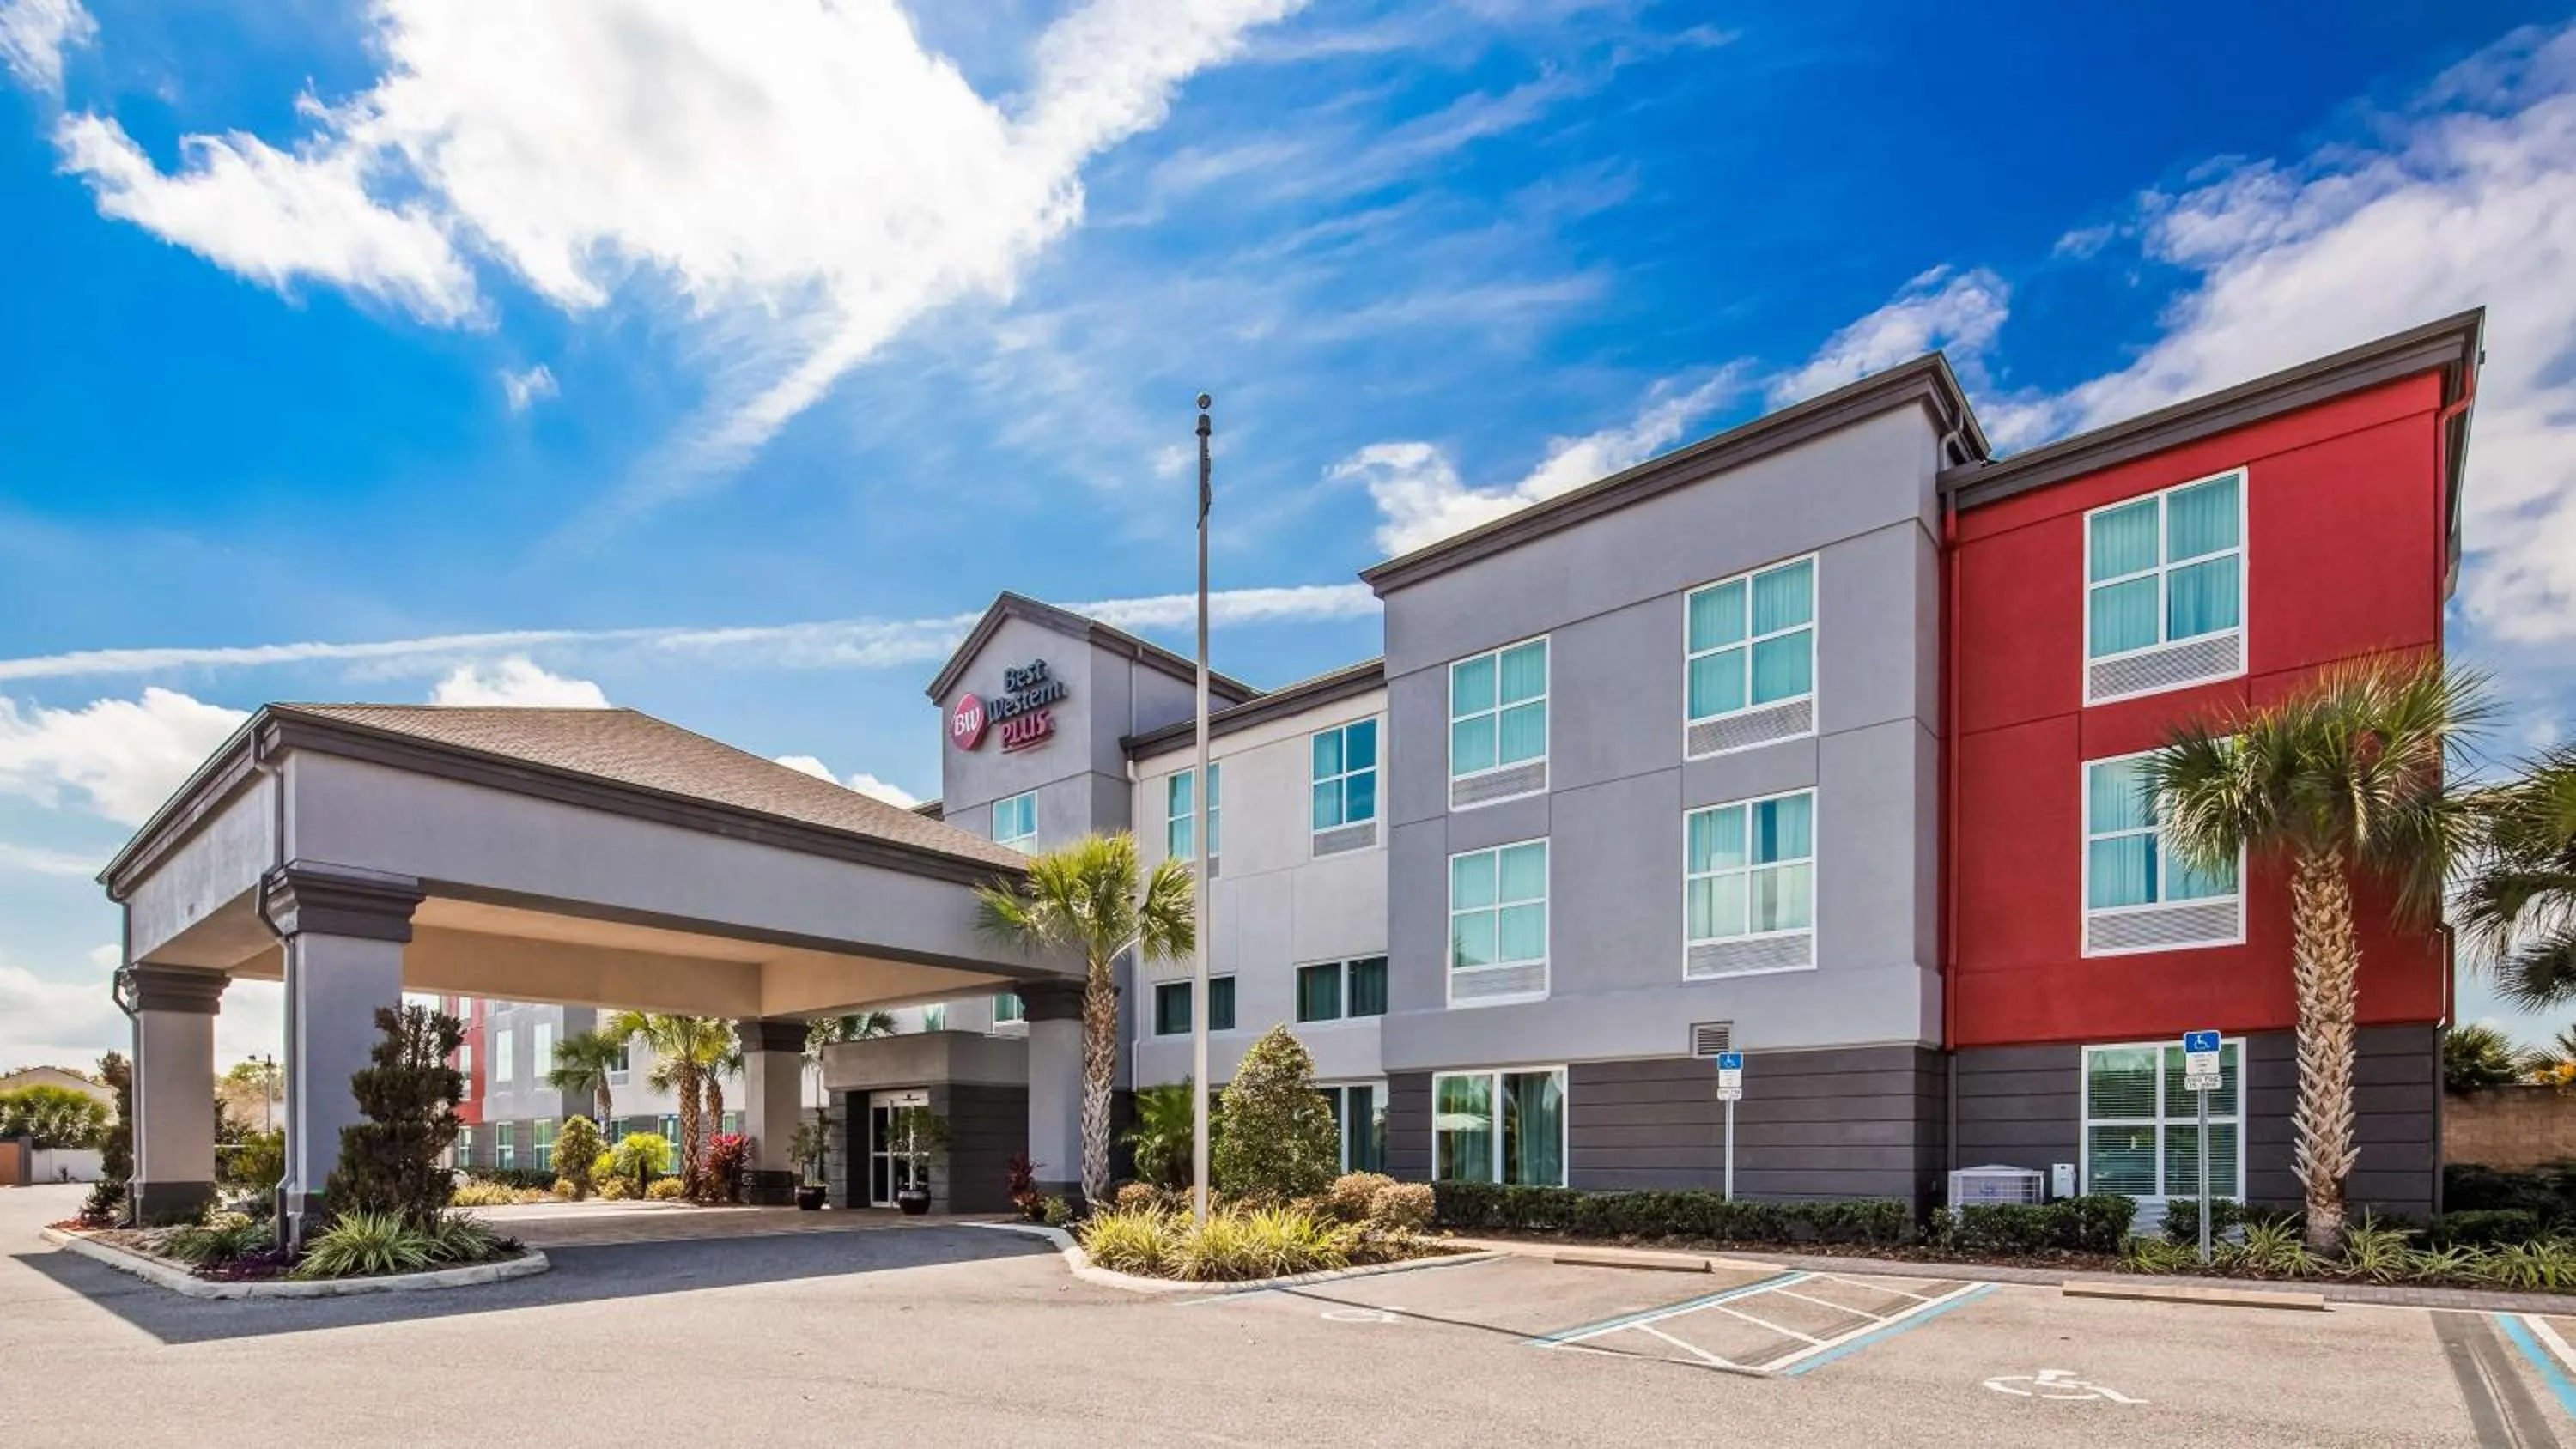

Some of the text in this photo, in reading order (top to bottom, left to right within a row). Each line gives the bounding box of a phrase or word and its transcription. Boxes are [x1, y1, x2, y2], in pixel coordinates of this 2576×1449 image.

[1003, 658, 1048, 693] Best
[987, 682, 1068, 723] Western
[953, 707, 981, 736] BW
[1000, 710, 1054, 749] PLUS
